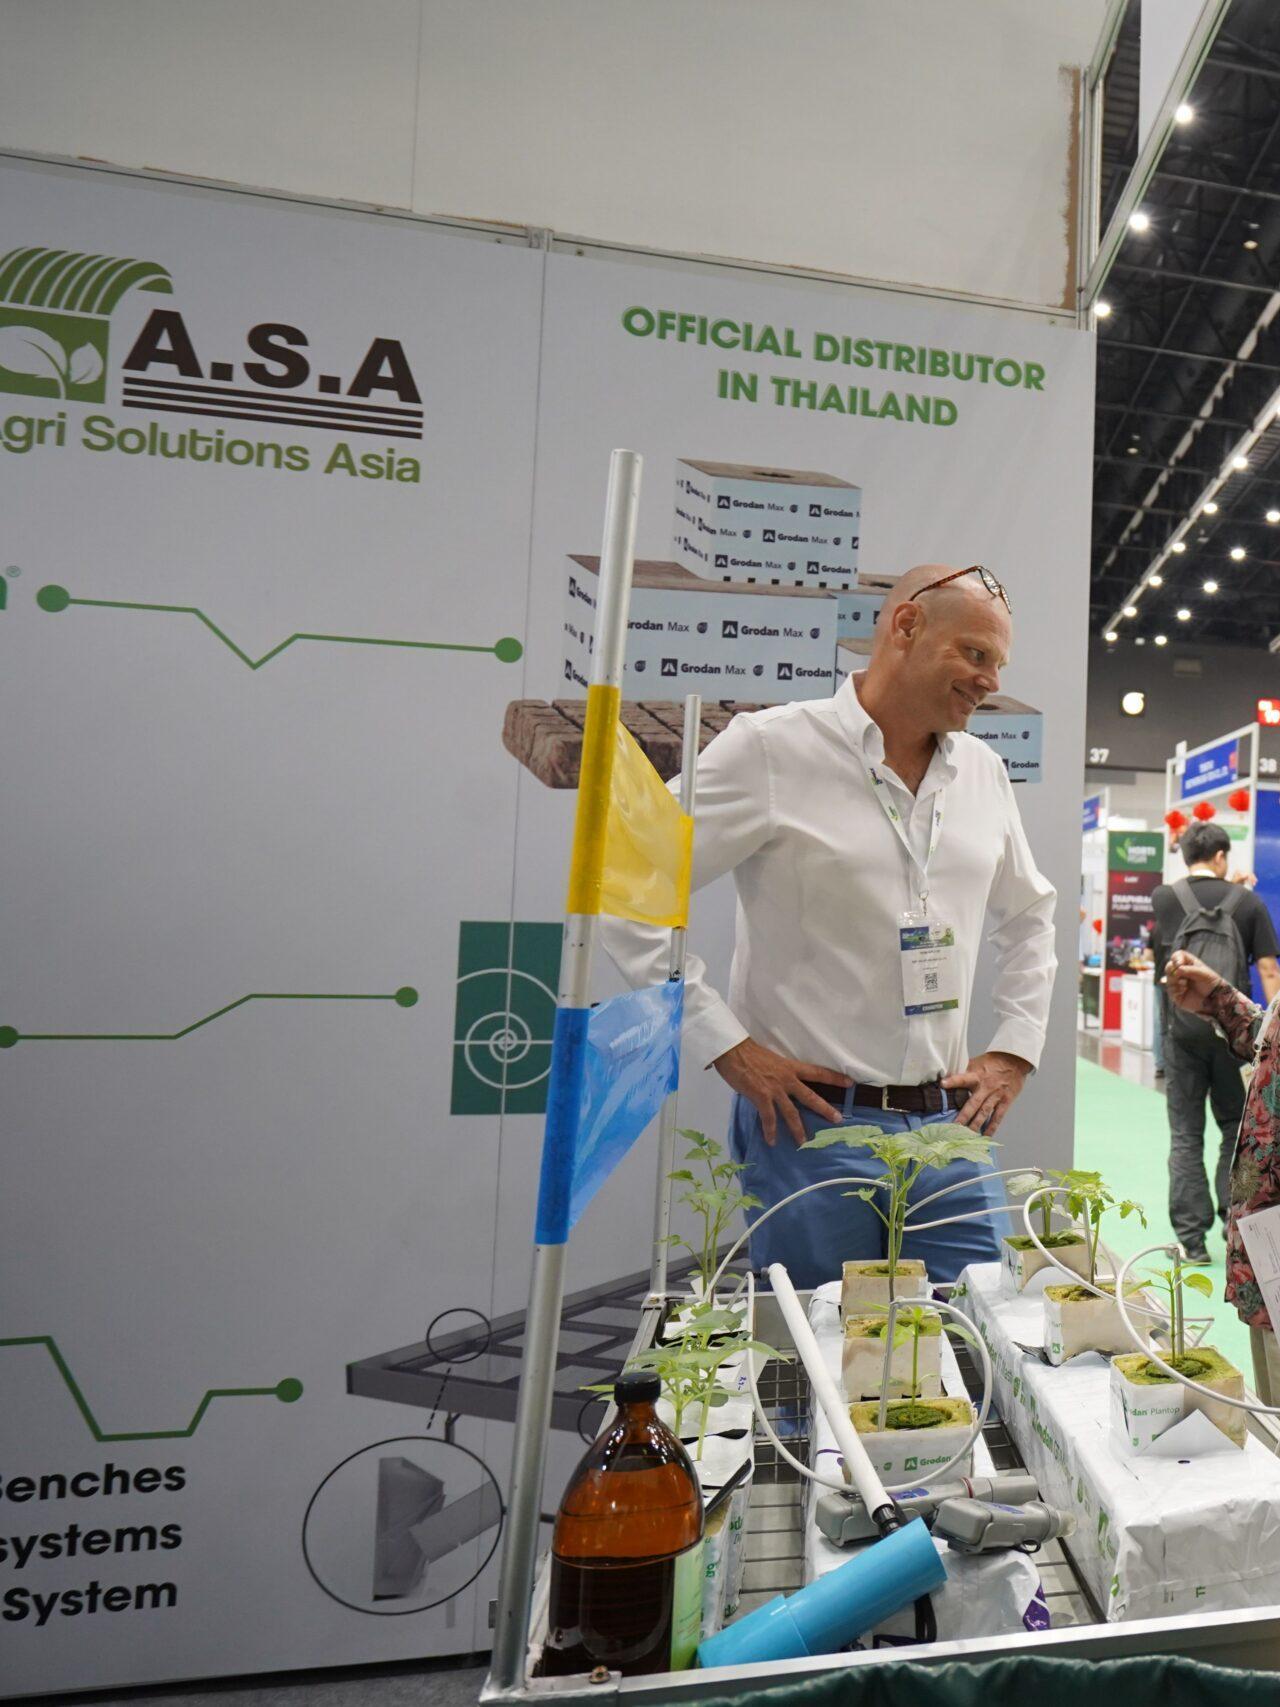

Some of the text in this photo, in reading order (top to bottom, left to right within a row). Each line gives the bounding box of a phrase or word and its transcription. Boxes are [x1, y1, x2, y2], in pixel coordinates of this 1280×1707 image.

[621, 305, 1047, 391] OFFICIAL DISTRIBUTOR
[122, 308, 423, 404] A.S.A
[717, 368, 959, 427] IN THAILAND
[0, 411, 421, 483] gri Solutions Asia
[733, 499, 785, 512] Grodan Max
[823, 508, 854, 518] Grodan
[719, 528, 737, 537] Max
[777, 532, 828, 545] Grodan Max
[730, 558, 783, 569] Grodan Max
[821, 564, 852, 575] Grodan
[627, 619, 690, 633] rodan Max
[741, 625, 803, 638] Grodan Max
[681, 662, 746, 676] Grodan Max
[795, 667, 832, 678] Grodan
[1001, 732, 1017, 740] Max
[1089, 747, 1109, 764] 37
[1010, 760, 1040, 769] Grodan
[1259, 757, 1277, 773] 38
[1150, 1406, 1181, 1417] Plantop
[920, 1455, 952, 1466] Grodan
[0, 1463, 187, 1503] enches
[2, 1579, 178, 1627] System
